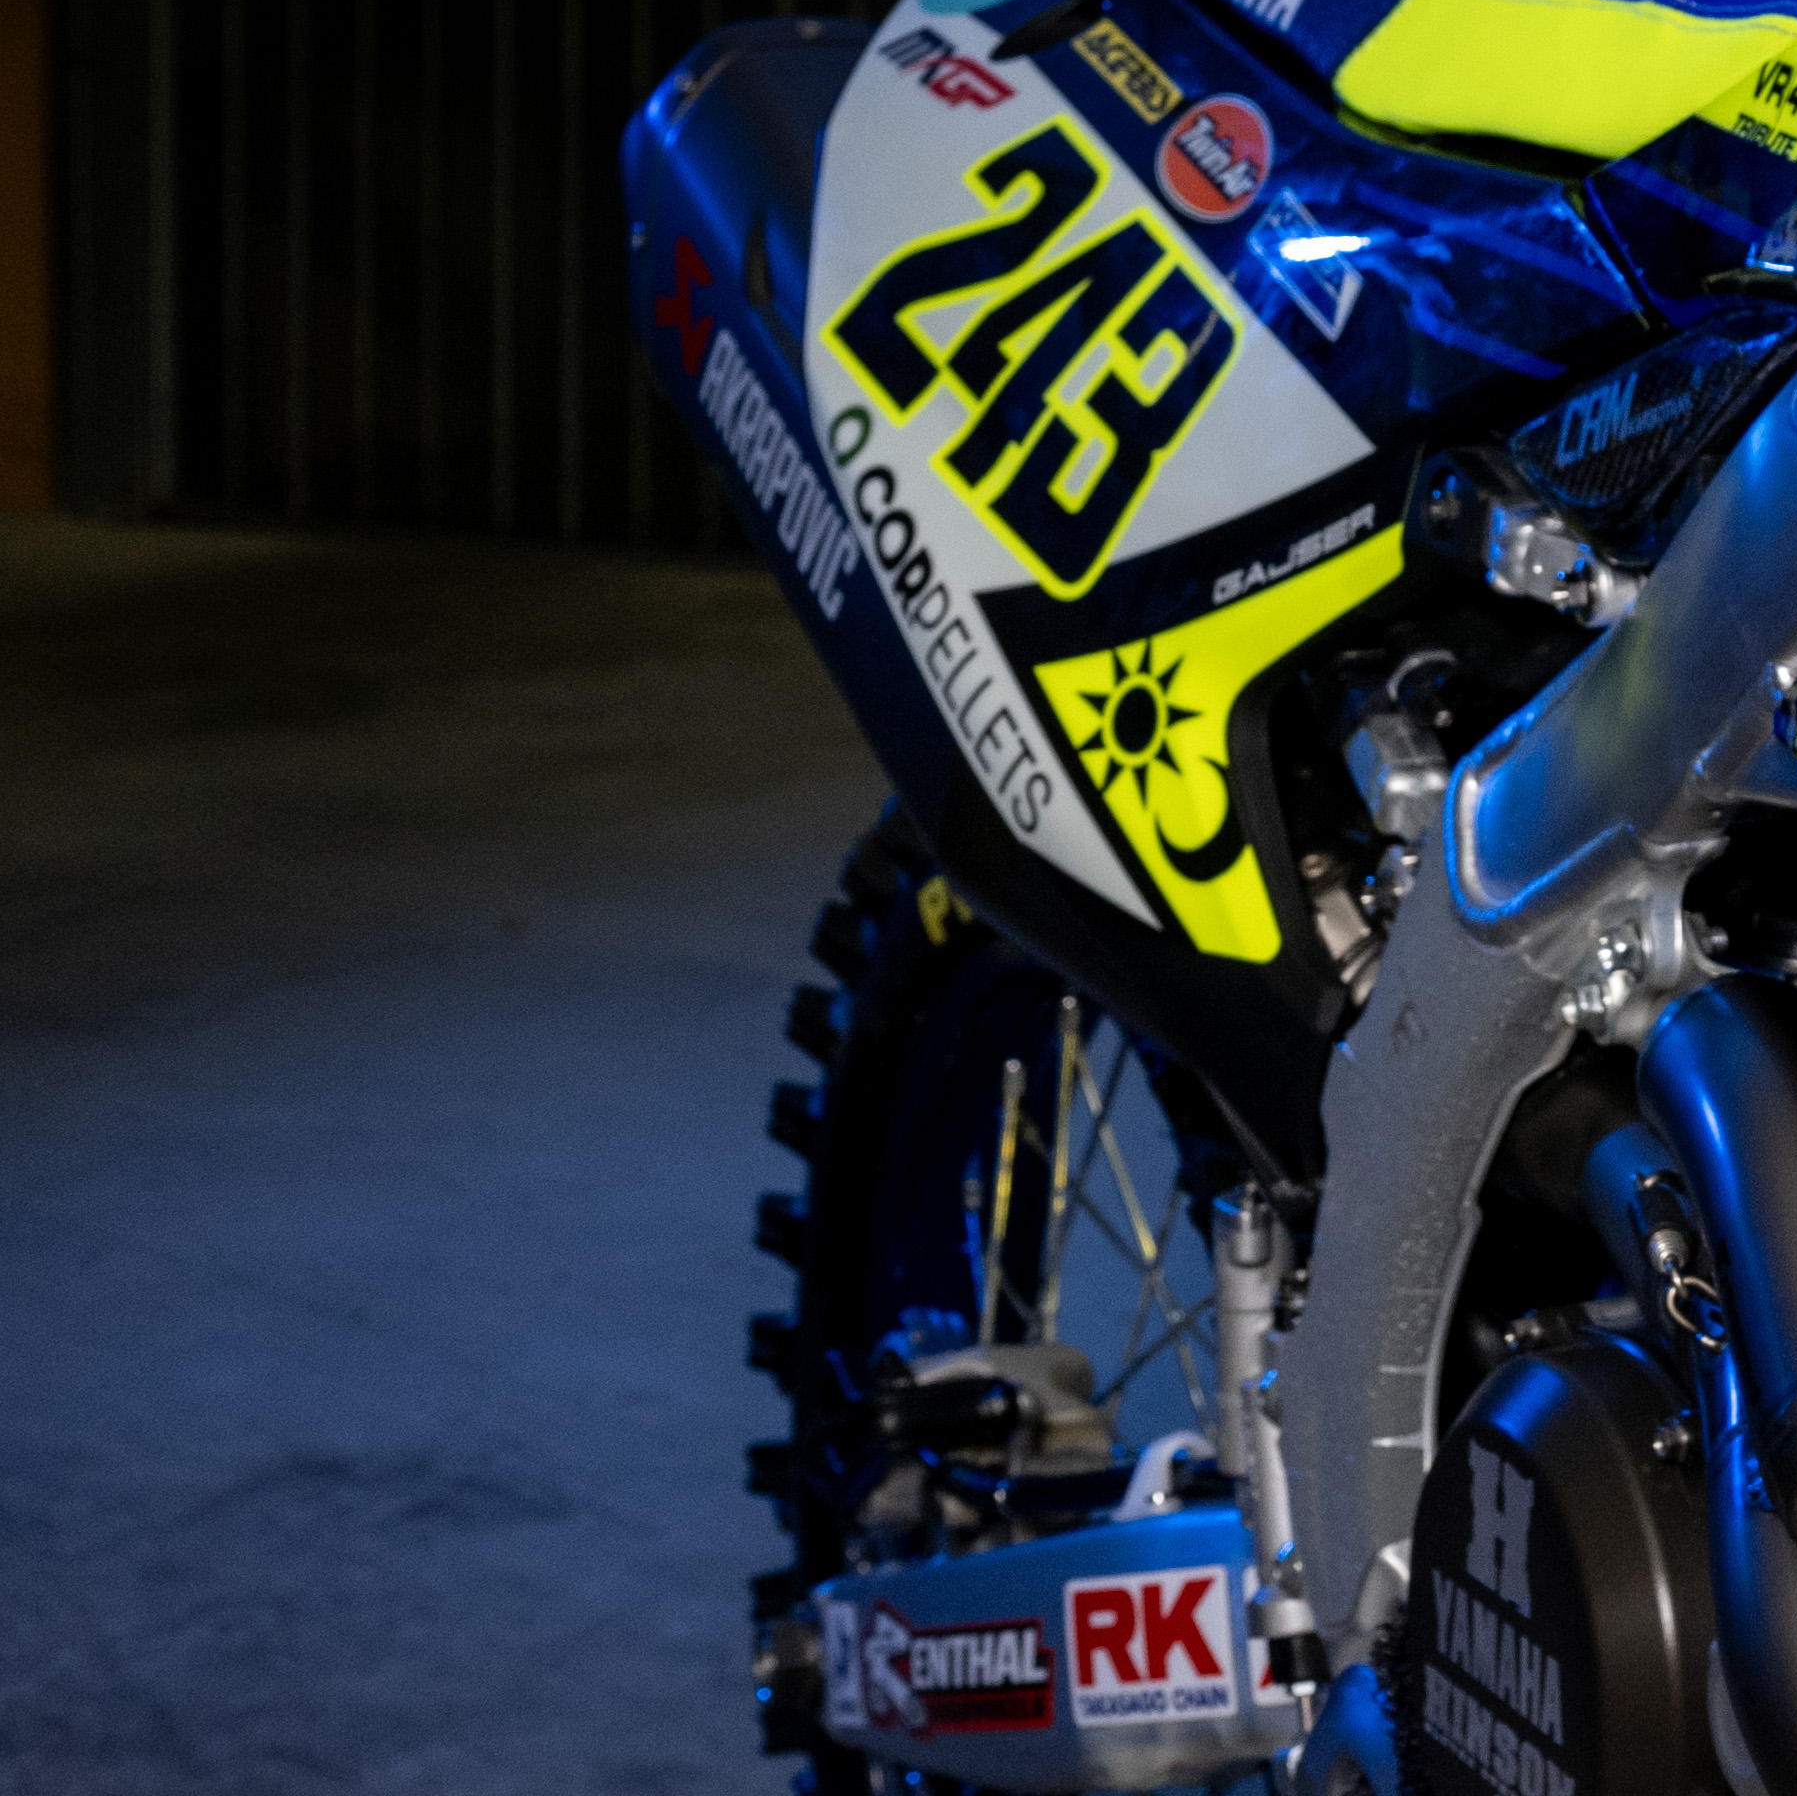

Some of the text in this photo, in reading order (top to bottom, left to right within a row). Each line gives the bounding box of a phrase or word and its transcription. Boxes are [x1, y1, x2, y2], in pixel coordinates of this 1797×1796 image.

[879, 26, 1017, 112] MXGP
[826, 118, 1238, 594] 243
[852, 464, 1053, 837] CORPELLETS
[1465, 1436, 1535, 1618] H
[1073, 1576, 1226, 1688] RK
[1432, 1568, 1565, 1746] YAMAHA
